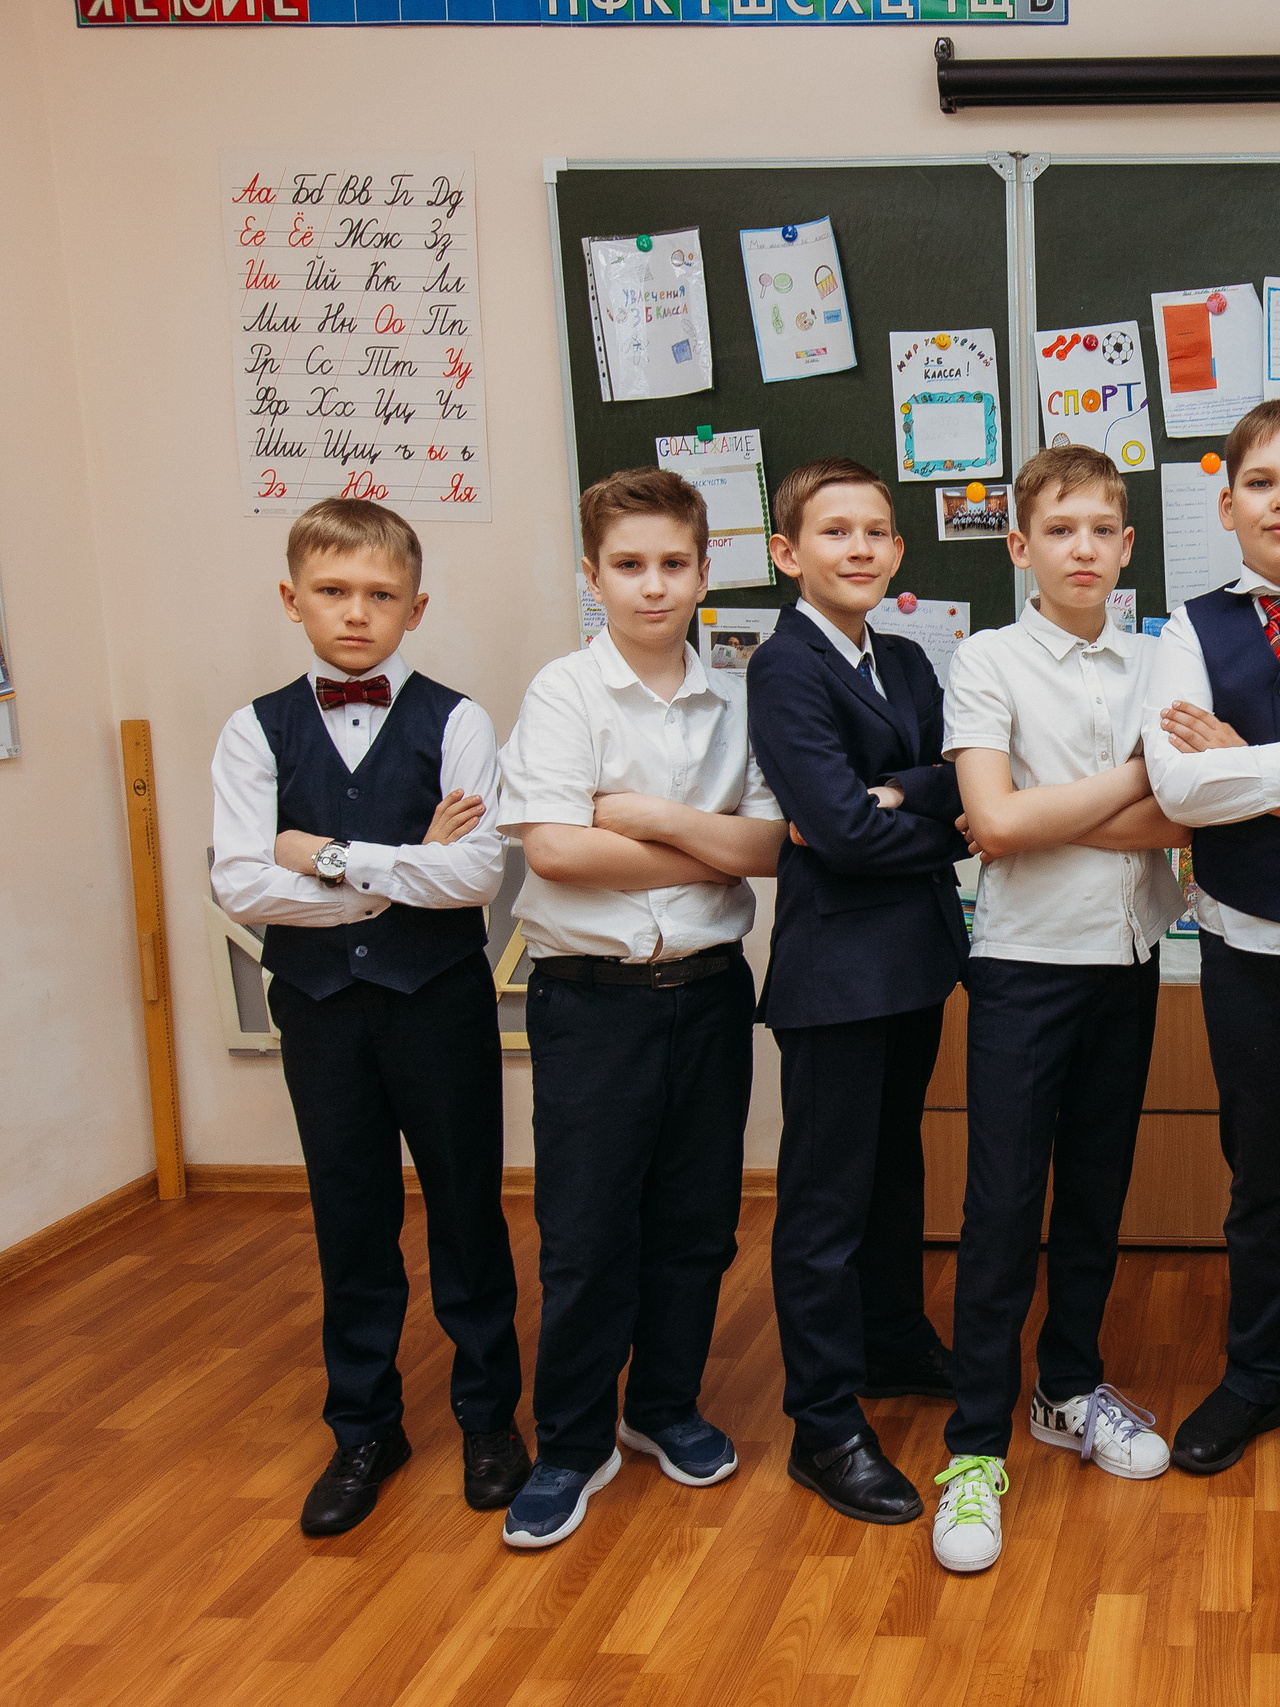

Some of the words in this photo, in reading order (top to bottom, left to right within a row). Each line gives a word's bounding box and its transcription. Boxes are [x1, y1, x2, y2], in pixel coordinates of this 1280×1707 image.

[232, 173, 276, 203] Аа
[292, 173, 337, 205] Бб
[338, 175, 372, 205] Вв
[384, 174, 414, 206] Гг
[426, 176, 463, 218] Дд
[239, 215, 266, 247] Ее
[287, 212, 315, 247] Ёё
[334, 217, 402, 249] Жж
[424, 219, 453, 261] Зз
[245, 260, 280, 290] Ии
[305, 256, 341, 291] Йй
[364, 261, 401, 292] Кк
[422, 264, 465, 292] Лл
[243, 302, 301, 334] Мм
[317, 302, 357, 335] Нн
[375, 304, 405, 334] Оо
[422, 305, 468, 336] Пп
[645, 306, 653, 323] Б
[245, 344, 280, 386] Рр
[305, 345, 334, 376] Сс
[358, 346, 417, 377] Тт
[442, 347, 472, 389] Уу
[249, 386, 289, 426] Фф
[306, 387, 355, 417] Хх
[374, 388, 415, 424] Цц
[435, 389, 467, 419] Чч
[1048, 382, 1141, 416] СПОРТ
[255, 427, 306, 458] Шш
[322, 428, 381, 465] Щщ
[394, 444, 414, 460] ъ
[427, 445, 448, 460] ы
[258, 469, 287, 498] Ээ
[340, 470, 389, 499] Юю
[440, 472, 476, 502] Яя
